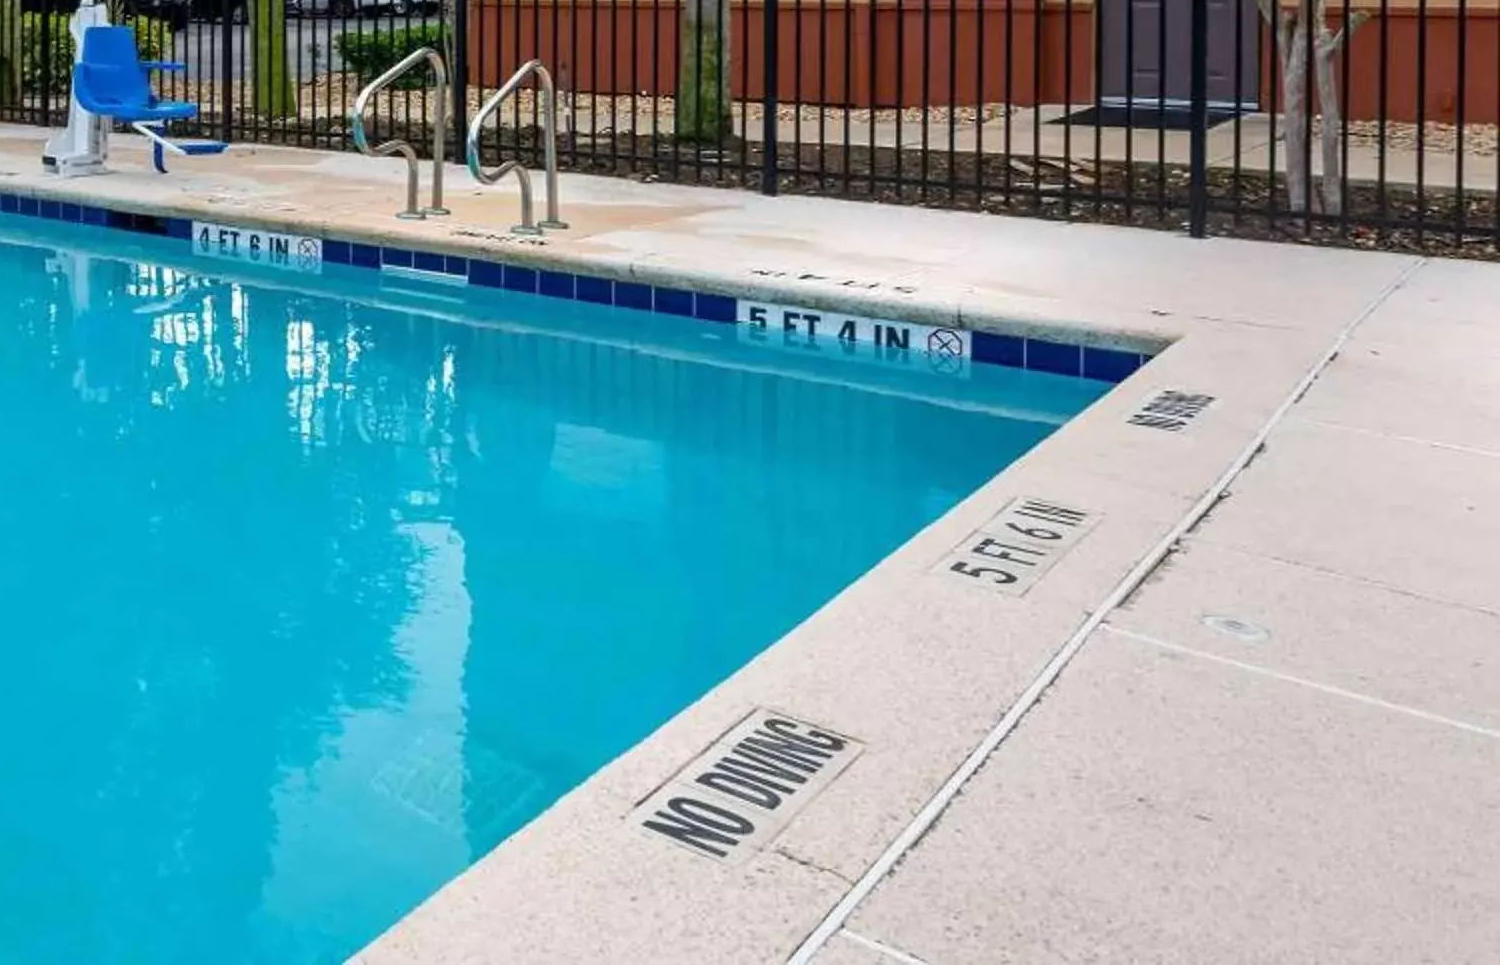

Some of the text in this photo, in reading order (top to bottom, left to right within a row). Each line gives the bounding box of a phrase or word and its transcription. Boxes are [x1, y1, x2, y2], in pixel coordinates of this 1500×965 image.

[220, 229, 240, 250] FT
[268, 236, 288, 256] IN
[750, 306, 910, 350] 5 FT 4 IN
[950, 500, 1087, 584] 5 FT 6 IN
[642, 718, 846, 858] NO DIVING
